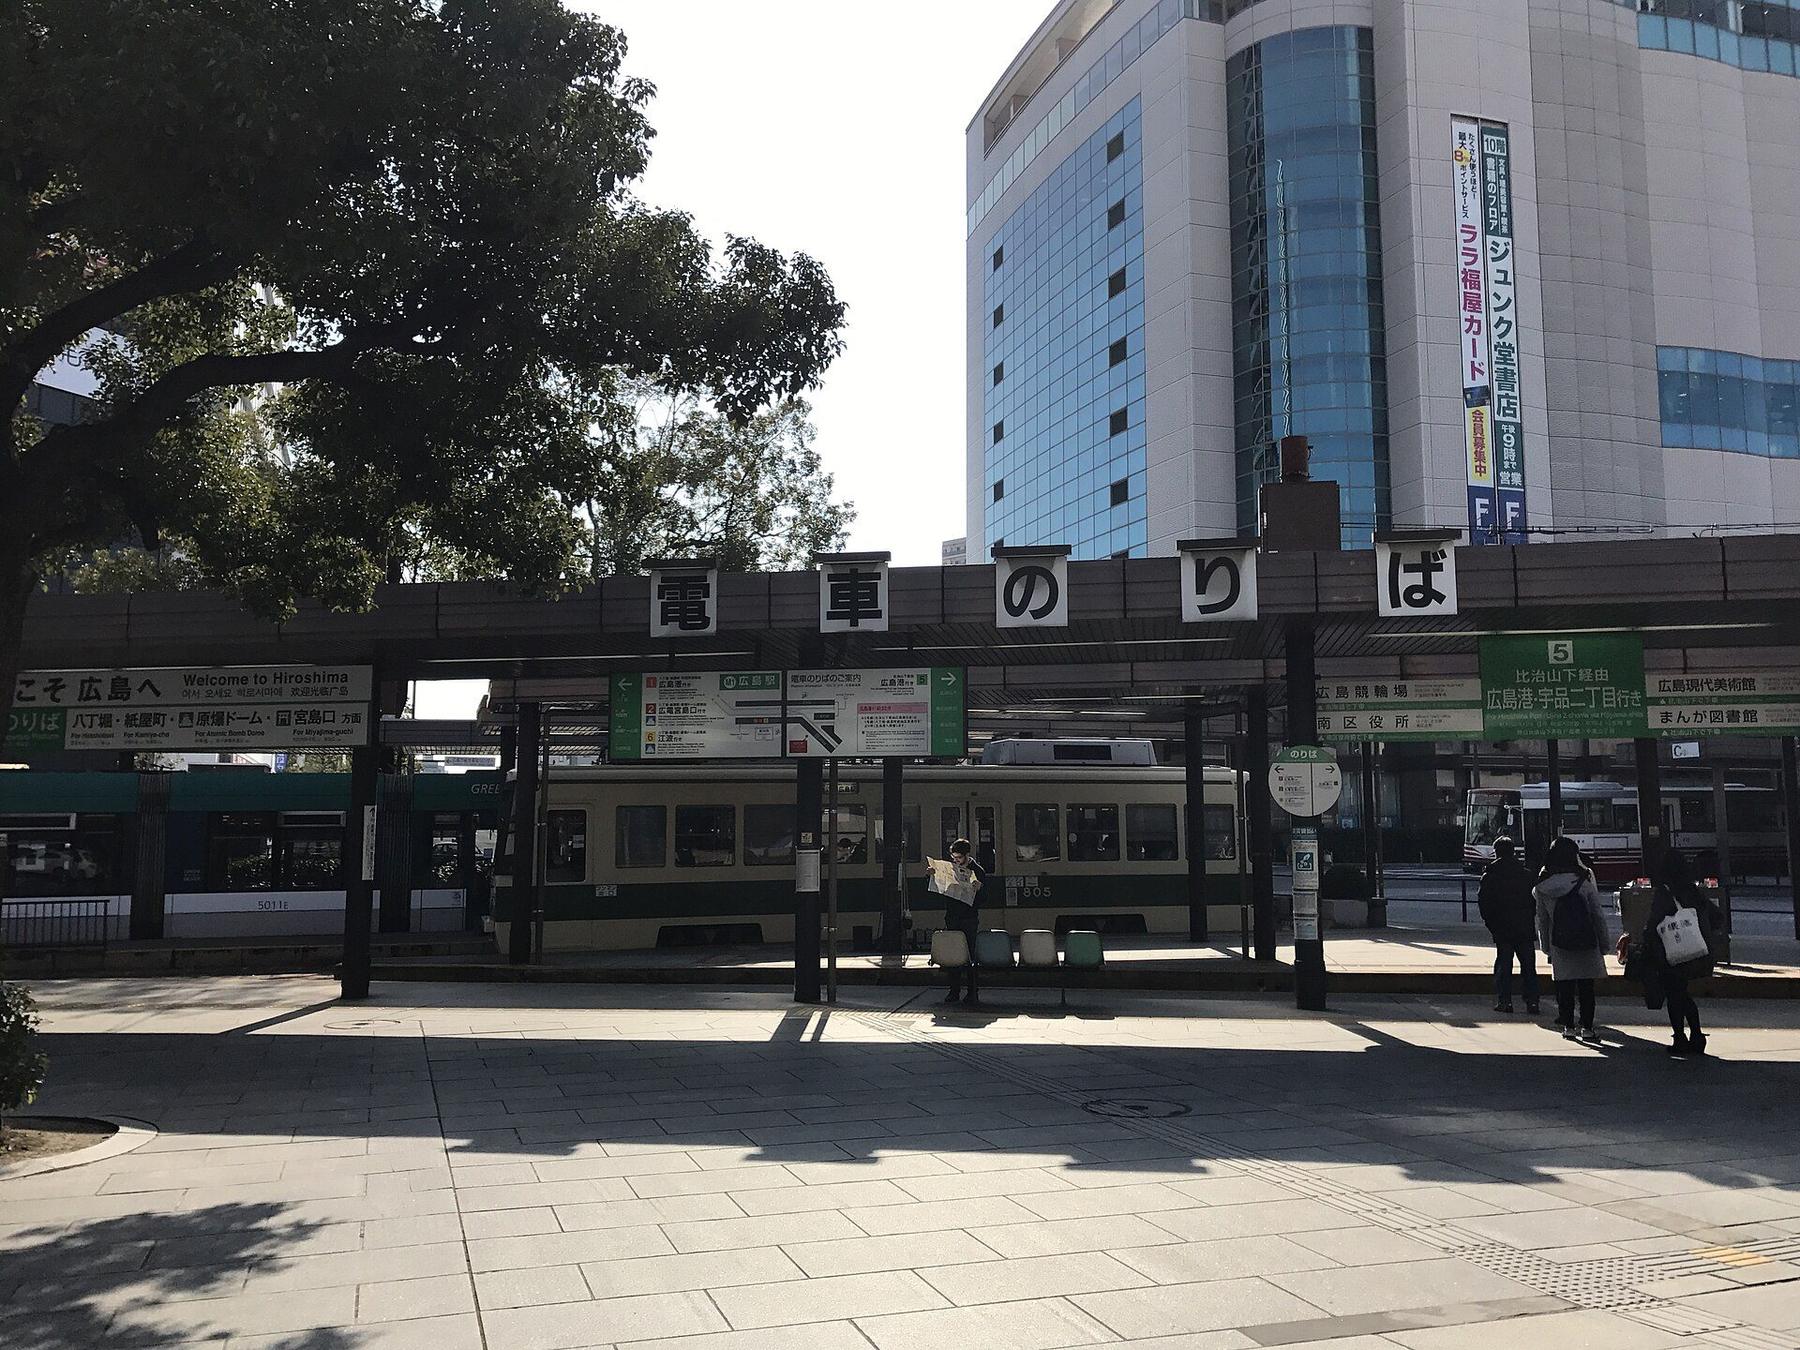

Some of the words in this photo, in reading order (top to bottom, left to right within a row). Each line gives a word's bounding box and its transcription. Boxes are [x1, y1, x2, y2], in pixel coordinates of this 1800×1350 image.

[1485, 138, 1505, 154] 10階
[1460, 224, 1485, 381] ララ福屋カード
[1489, 240, 1518, 418] ジュンク堂書店
[1472, 410, 1487, 477] 会員募集中
[1475, 498, 1489, 526] F
[1506, 502, 1520, 529] F
[657, 550, 1446, 632] 電車のりば
[1553, 643, 1568, 661] 5
[184, 674, 249, 686] Welcome
[254, 674, 267, 685] to
[273, 672, 348, 685] Hiroshima
[738, 675, 775, 687] 広島駅
[791, 674, 861, 684] 電車のりばのご案内
[1515, 668, 1609, 683] 比治山下経由
[1316, 684, 1408, 699] 広島競輪場
[1658, 677, 1756, 693] 広島現代美術館
[294, 709, 336, 725] 宮島口
[341, 712, 361, 724] 方面
[1317, 715, 1409, 730] 南区役所
[1660, 709, 1758, 724] まんが図書館
